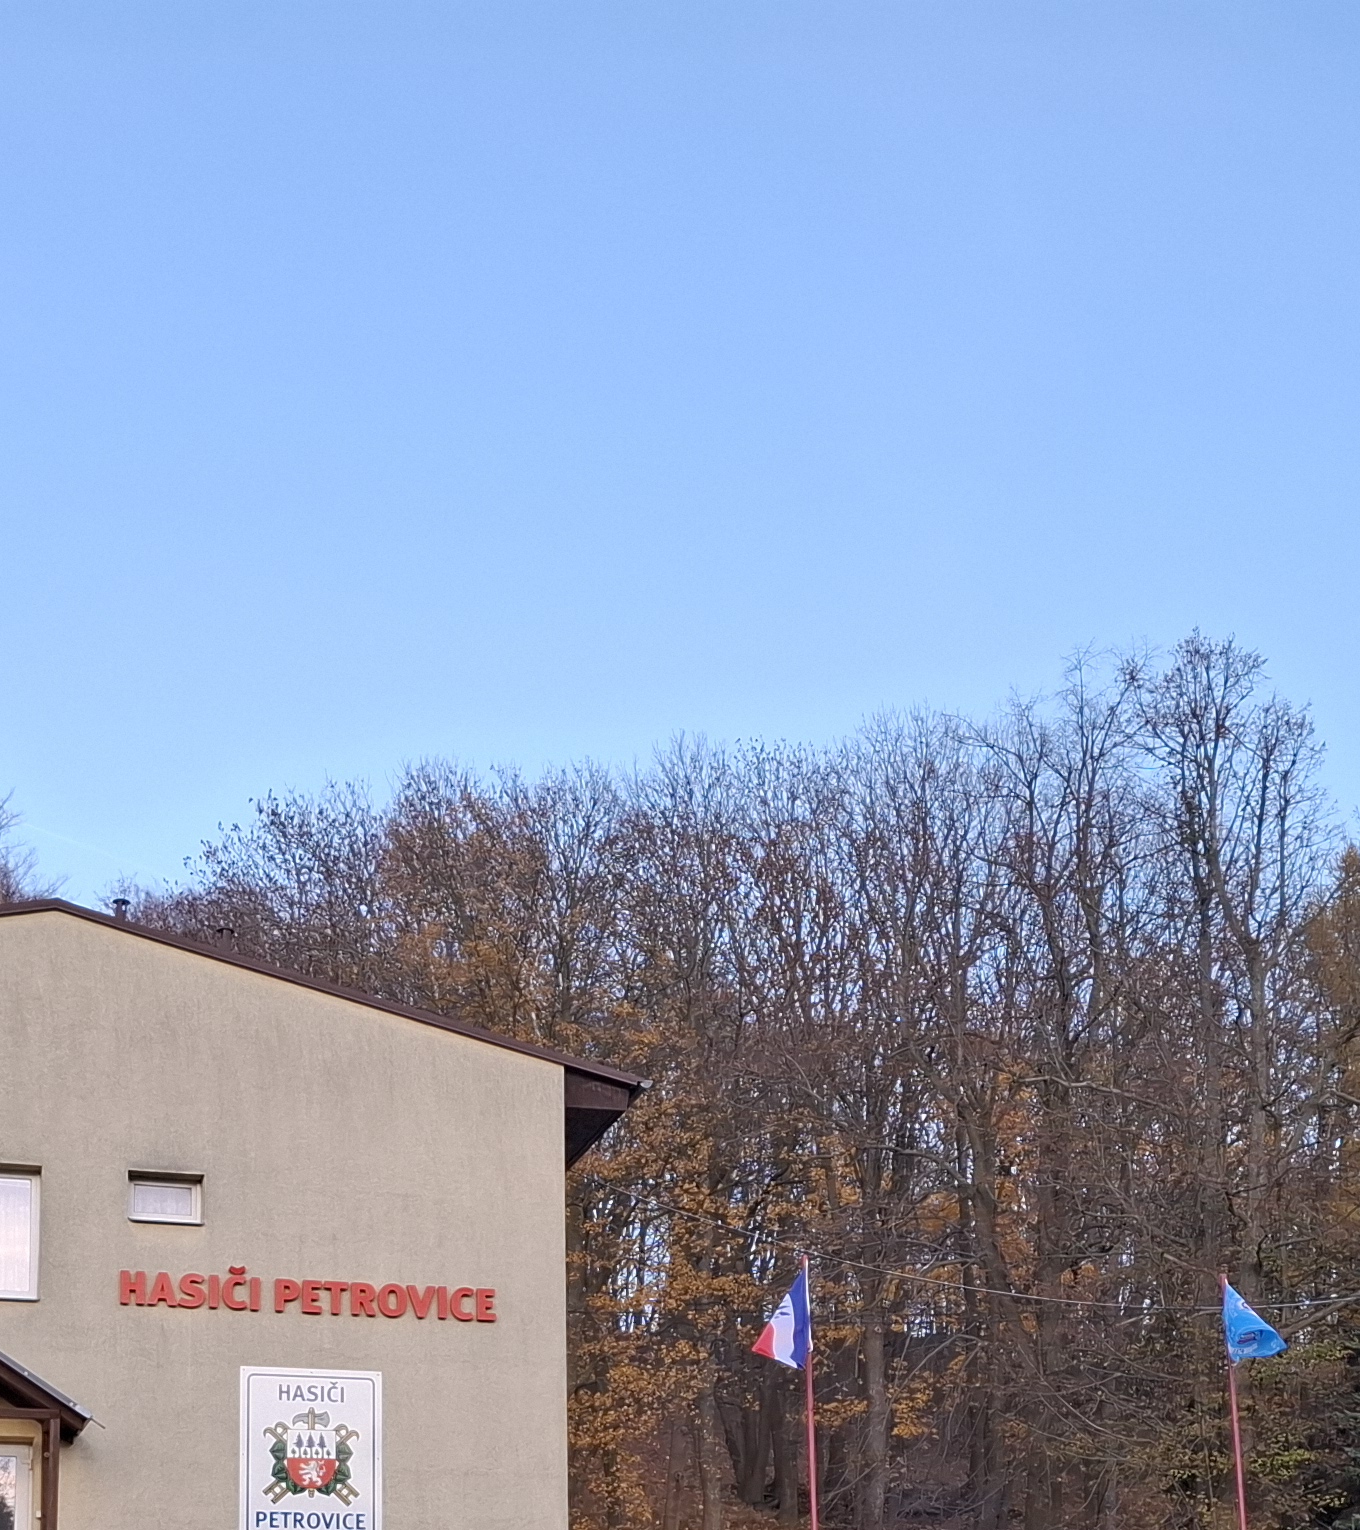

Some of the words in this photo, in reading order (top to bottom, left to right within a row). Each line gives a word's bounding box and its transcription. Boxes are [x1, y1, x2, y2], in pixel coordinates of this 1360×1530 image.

[119, 1265, 261, 1312] HASIČI
[274, 1278, 497, 1322] PETROVICE
[278, 1381, 345, 1403] HASIČI
[255, 1510, 366, 1530] PETROVICE
